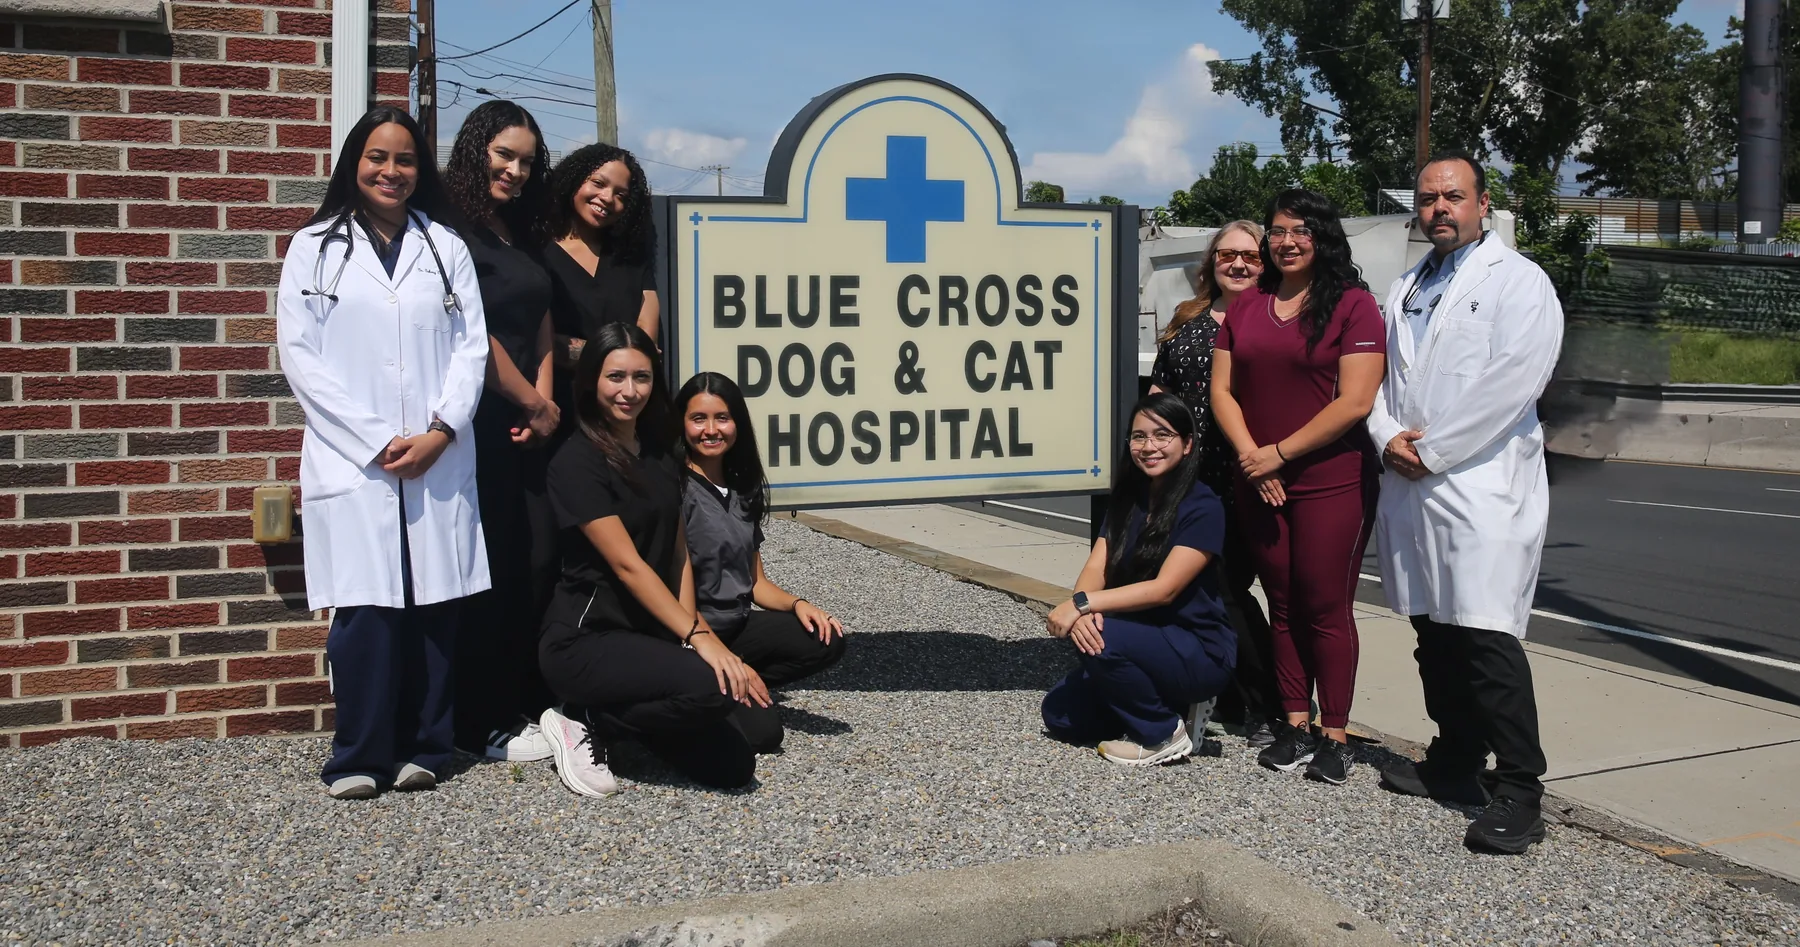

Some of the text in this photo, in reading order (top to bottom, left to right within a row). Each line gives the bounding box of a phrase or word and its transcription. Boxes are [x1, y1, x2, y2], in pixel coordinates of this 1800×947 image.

[713, 273, 1080, 328] BLUE CROSS
[737, 340, 1063, 398] DOG & CAT
[767, 406, 1034, 468] HOSPITAL
